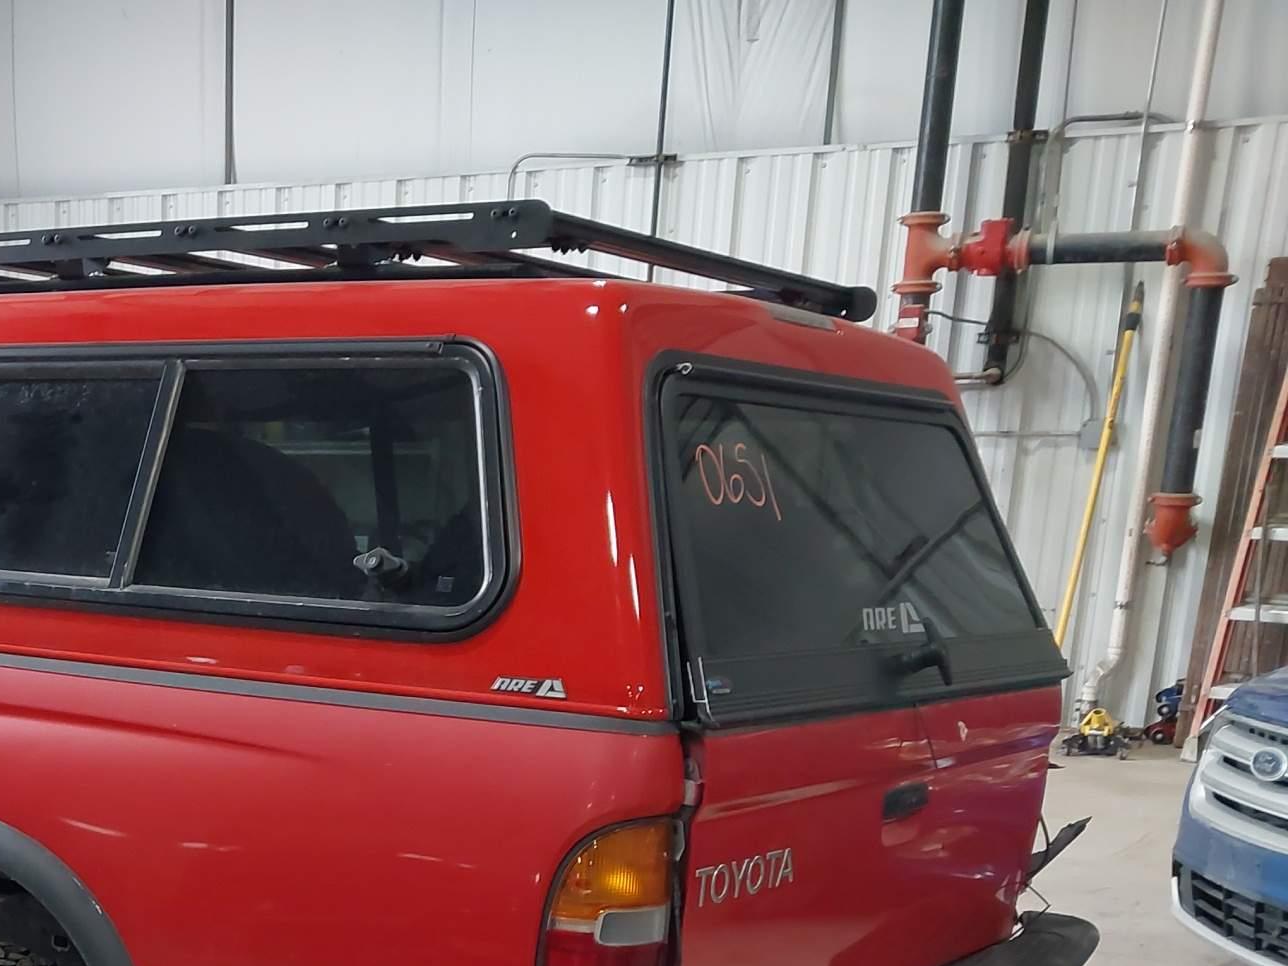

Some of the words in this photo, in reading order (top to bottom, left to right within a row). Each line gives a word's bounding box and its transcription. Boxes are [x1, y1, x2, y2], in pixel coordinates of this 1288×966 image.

[695, 443, 781, 521] 0651
[861, 607, 897, 631] ARE
[490, 676, 538, 693] ARE
[695, 847, 794, 908] TOYOTA
